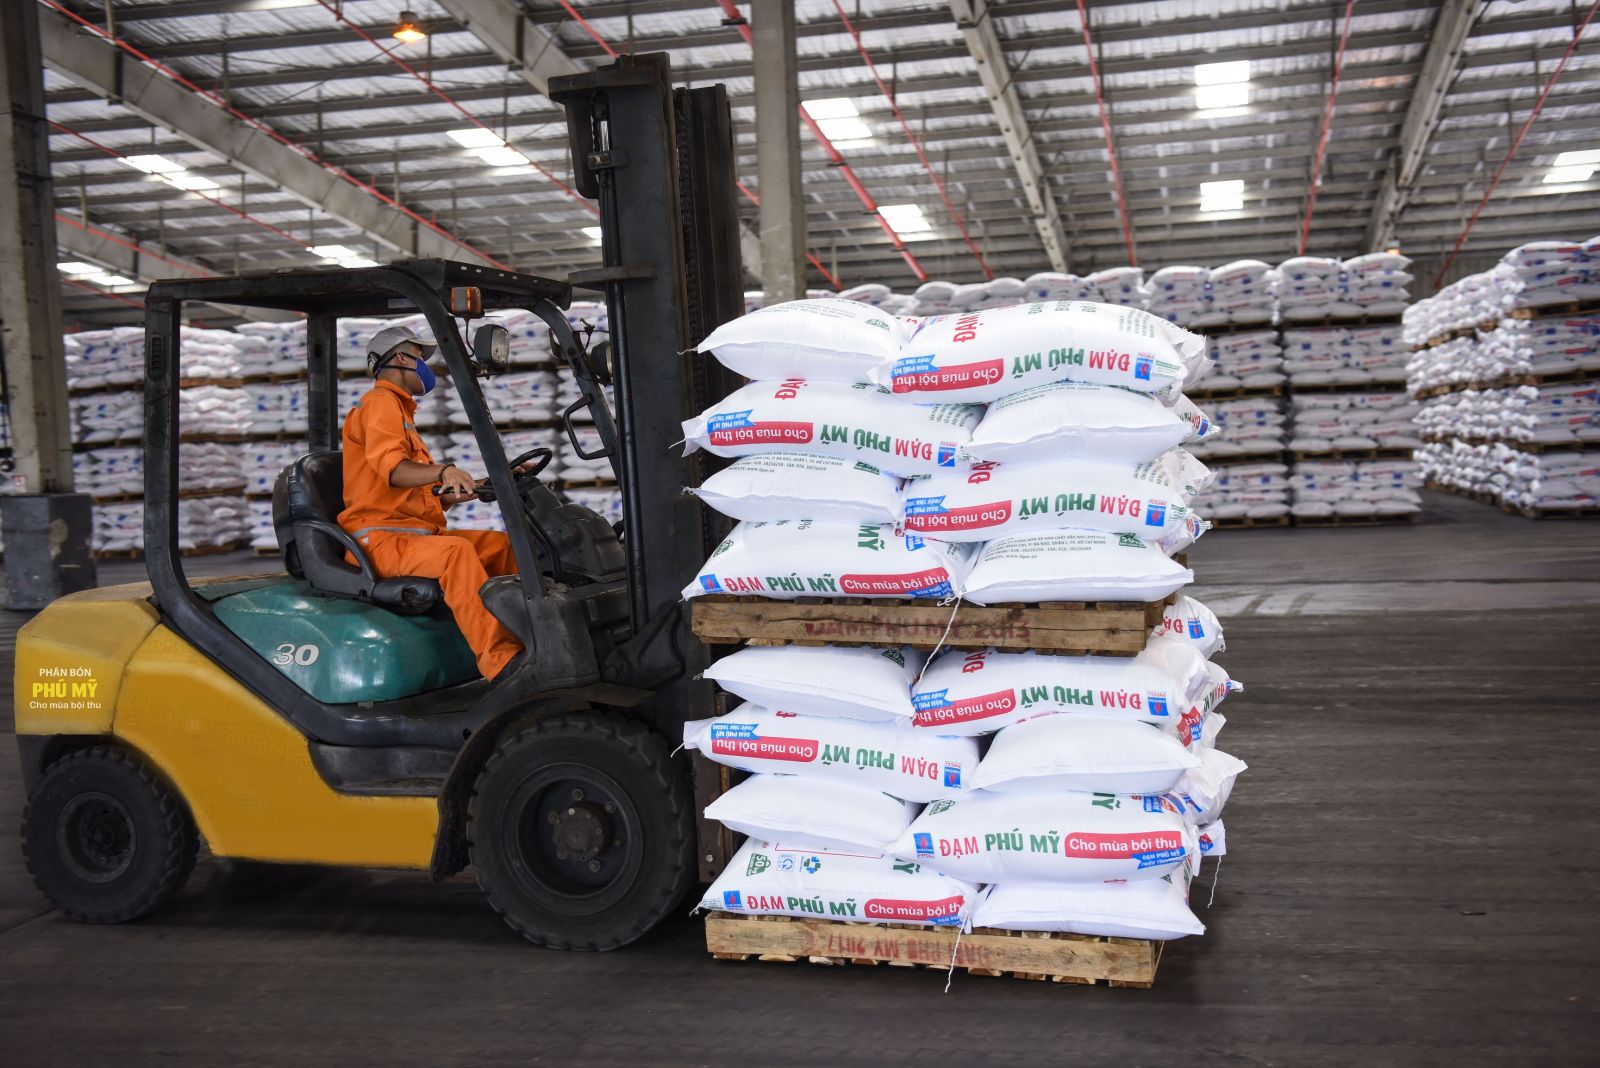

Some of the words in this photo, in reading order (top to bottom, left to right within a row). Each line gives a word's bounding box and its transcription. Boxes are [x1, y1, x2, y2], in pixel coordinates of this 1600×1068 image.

[1012, 352, 1042, 379] MỸ
[1048, 348, 1085, 372] PHÚ
[1089, 351, 1131, 372] ĐẠM
[895, 374, 917, 386] thu
[918, 371, 939, 387] bội
[941, 369, 976, 386] mùa
[977, 367, 1000, 381] Cho
[775, 377, 809, 400] ĐẠ
[713, 428, 732, 442] thu
[733, 428, 755, 442] bội
[756, 428, 785, 442] mùa
[786, 428, 809, 441] Cho
[820, 424, 849, 446] MỸ
[853, 428, 892, 457] PHÚ
[894, 438, 933, 461] ĐẠM
[1018, 496, 1049, 520] MỸ
[1055, 493, 1096, 516] PHÚ
[1100, 494, 1141, 519] ĐẠM
[905, 514, 925, 529] thu
[928, 513, 948, 528] bội
[951, 511, 982, 526] mùa
[985, 508, 1007, 521] Cho
[857, 524, 885, 551] MỸ
[724, 576, 764, 593] ĐẠM
[766, 573, 805, 593] PHÚ
[806, 572, 837, 593] MỸ
[844, 579, 870, 591] Cho
[872, 579, 900, 590] mùa
[901, 577, 923, 590] bội
[924, 574, 946, 586] thu
[273, 643, 320, 666] 30
[39, 667, 67, 677] PHÂN
[69, 666, 92, 677] BÓN
[32, 678, 67, 698] PHÚ
[71, 678, 99, 698] MỸ
[1020, 686, 1049, 708] MỸ
[1053, 685, 1094, 706] PHÚ
[29, 701, 48, 710] Cho
[49, 701, 69, 710] mùa
[70, 700, 86, 711] bội
[87, 701, 102, 710] thu
[956, 701, 984, 717] mùa
[986, 697, 1012, 710] Cho
[1100, 690, 1142, 710] ĐẠM
[935, 704, 955, 721] bội
[715, 739, 737, 752] thu
[738, 740, 758, 753] bội
[760, 742, 789, 757] mùa
[788, 745, 814, 758] Cho
[821, 744, 850, 766] MỸ
[856, 748, 895, 771] PHÚ
[901, 755, 939, 781] ĐẠM
[939, 836, 980, 859] ĐẠM
[984, 828, 1024, 852] PHÚ
[1030, 831, 1060, 854] MỸ
[1069, 837, 1098, 851] Cho
[1099, 838, 1129, 852] mùa
[1131, 838, 1152, 852] bội
[1155, 837, 1177, 849] thu
[1156, 851, 1170, 859] PHÚ
[892, 859, 921, 875] Ỹ
[747, 895, 785, 911] ĐẠM
[787, 895, 825, 915] PHÚ
[829, 898, 857, 917] MỸ
[868, 903, 893, 915] Cho
[896, 905, 924, 917] mùa
[927, 904, 946, 917] bội
[949, 902, 960, 913] th
[873, 938, 900, 959] MY
